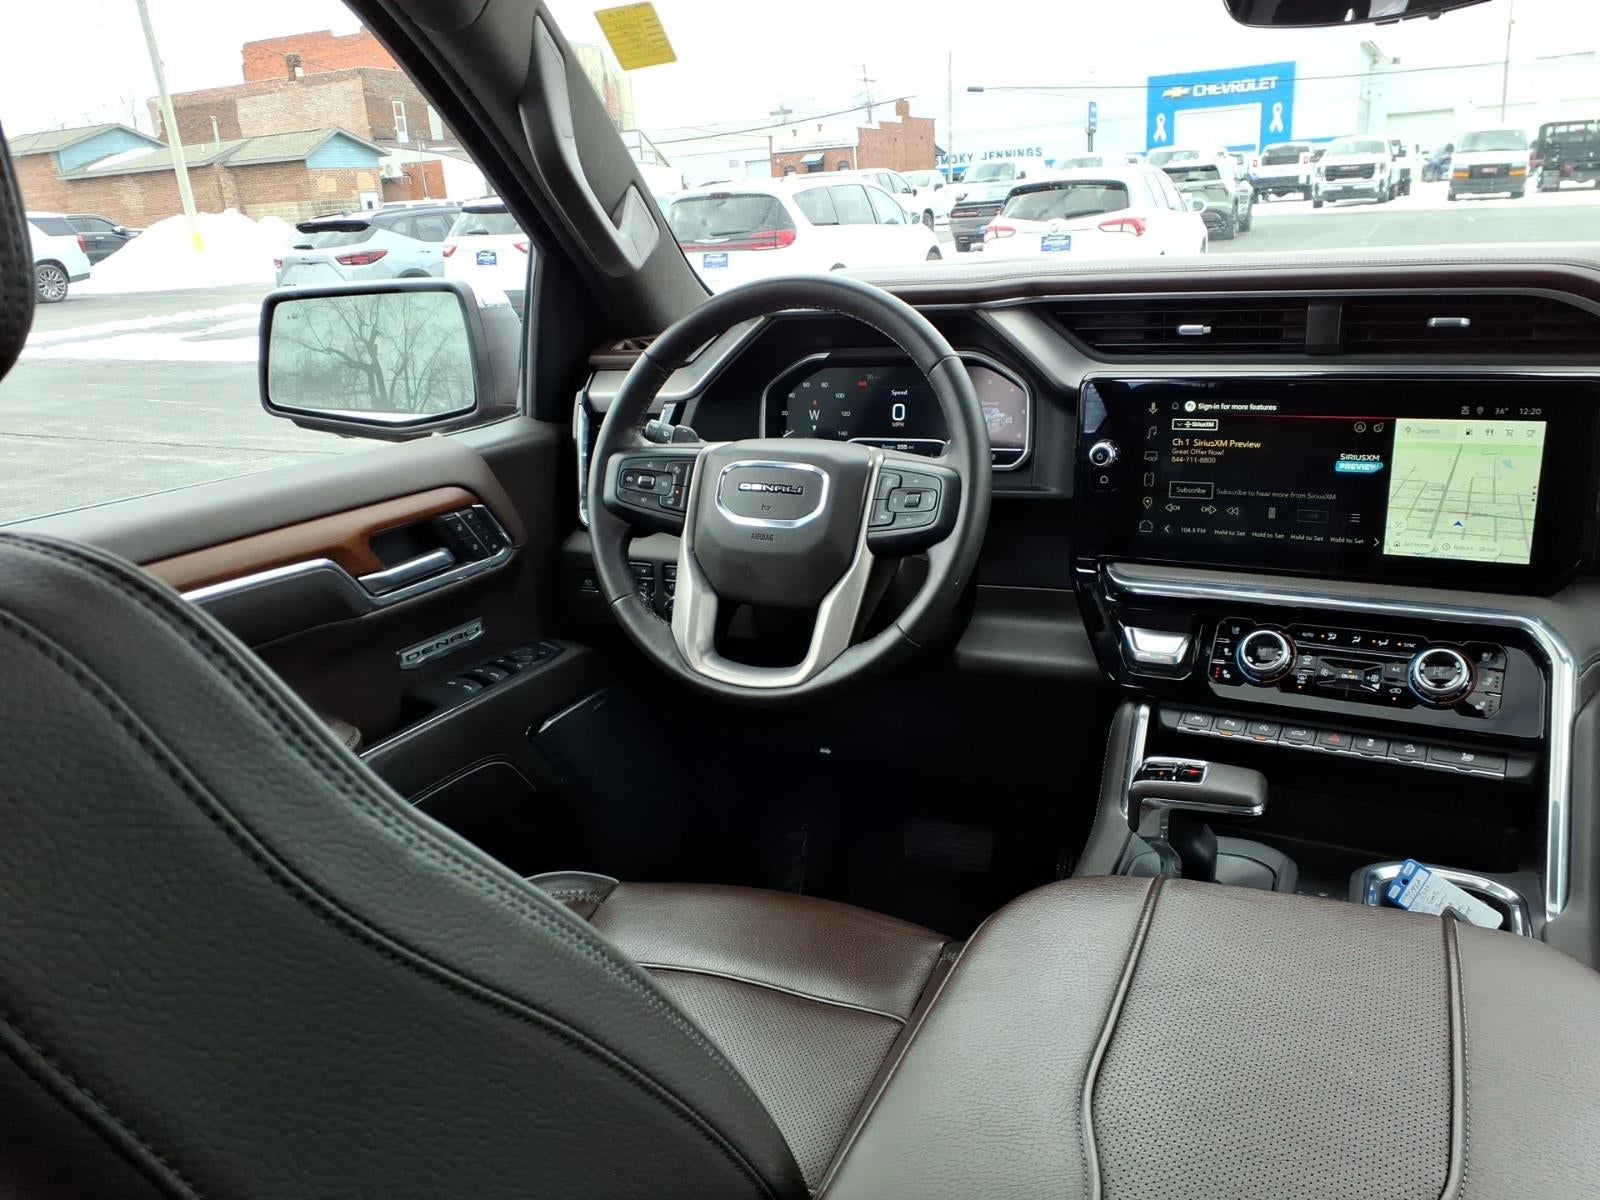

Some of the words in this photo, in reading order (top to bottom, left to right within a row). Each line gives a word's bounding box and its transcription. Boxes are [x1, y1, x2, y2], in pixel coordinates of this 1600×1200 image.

[1192, 76, 1279, 97] CHEVROLET
[981, 147, 1043, 160] JENNINGS
[892, 403, 906, 421] 0
[1197, 403, 1220, 412] Sign-in
[1221, 403, 1230, 411] for
[1249, 403, 1277, 411] features
[1519, 407, 1542, 415] 12:20
[809, 409, 820, 421] W
[1416, 427, 1440, 435] Search
[1172, 438, 1184, 446] Ch
[1185, 438, 1190, 446] 1
[1193, 438, 1228, 448] SiriusXM
[1229, 440, 1262, 449] Preview
[1339, 452, 1380, 461] SIRIUSXM
[1176, 486, 1207, 495] Subscribe
[1216, 488, 1247, 496] Subscribe
[1256, 489, 1273, 497] hear
[1273, 491, 1289, 499] more
[1290, 491, 1306, 499] from
[750, 532, 774, 541] AIRBAG
[1214, 529, 1229, 537] Hold
[1236, 530, 1246, 538] Set
[1251, 531, 1266, 539] Hold
[1267, 532, 1273, 540] to
[1313, 535, 1324, 543] Set
[407, 626, 480, 662] DENALI
